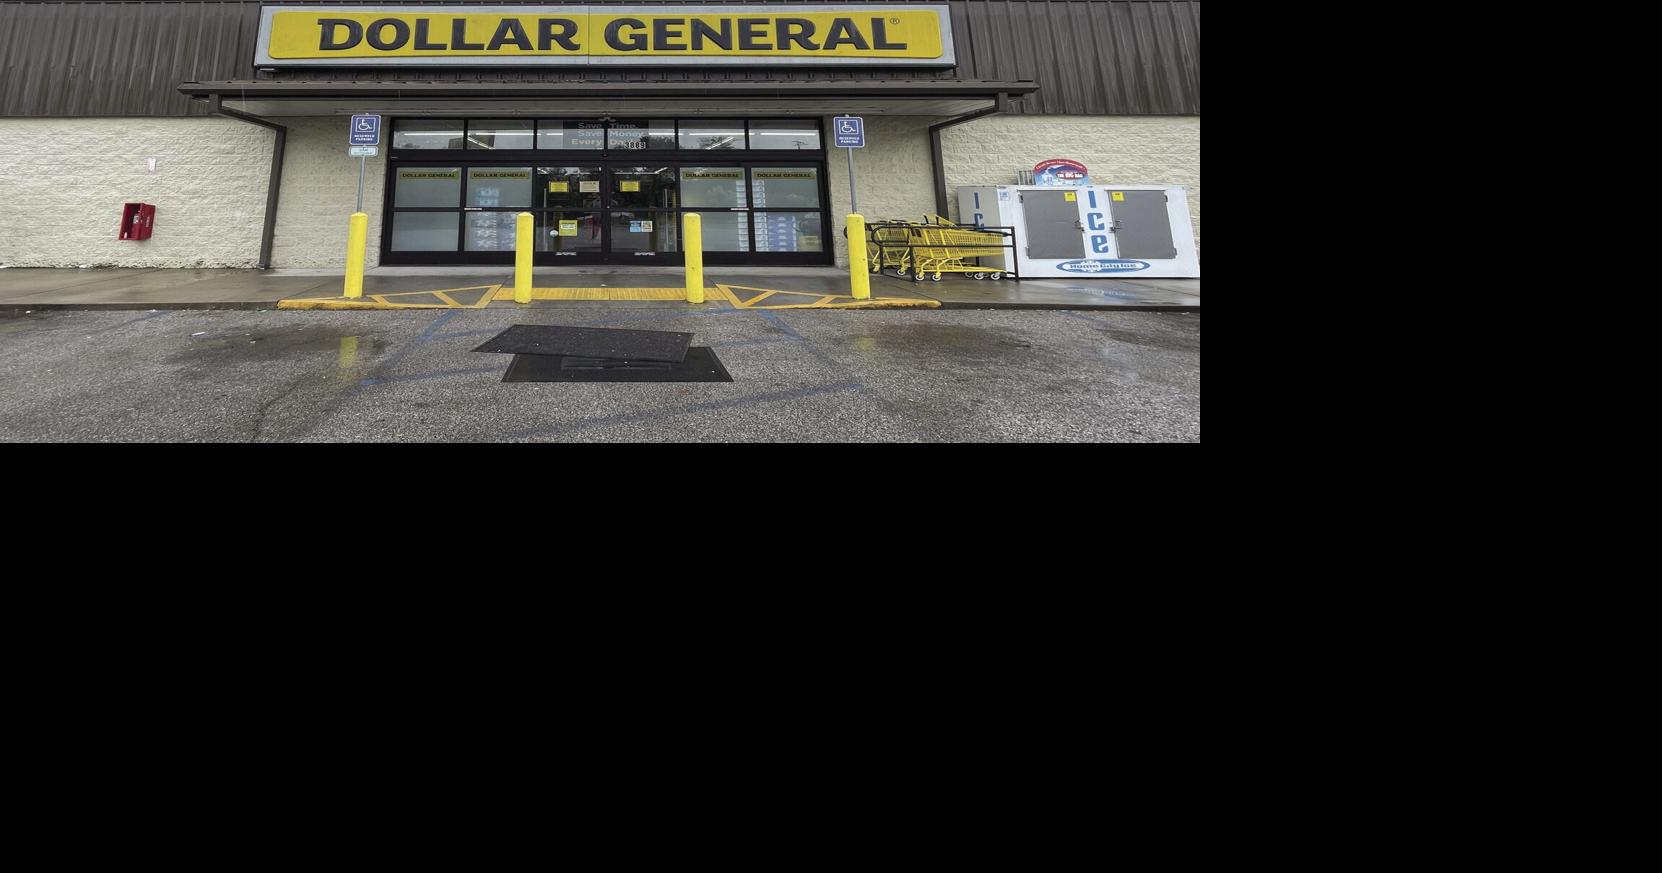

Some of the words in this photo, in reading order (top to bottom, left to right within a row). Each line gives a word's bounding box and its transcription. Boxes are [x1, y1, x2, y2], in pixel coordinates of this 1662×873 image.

[317, 18, 581, 51] DOLLAR
[604, 17, 908, 51] GENERAL
[571, 138, 602, 146] Every
[1087, 190, 1109, 253] Ice
